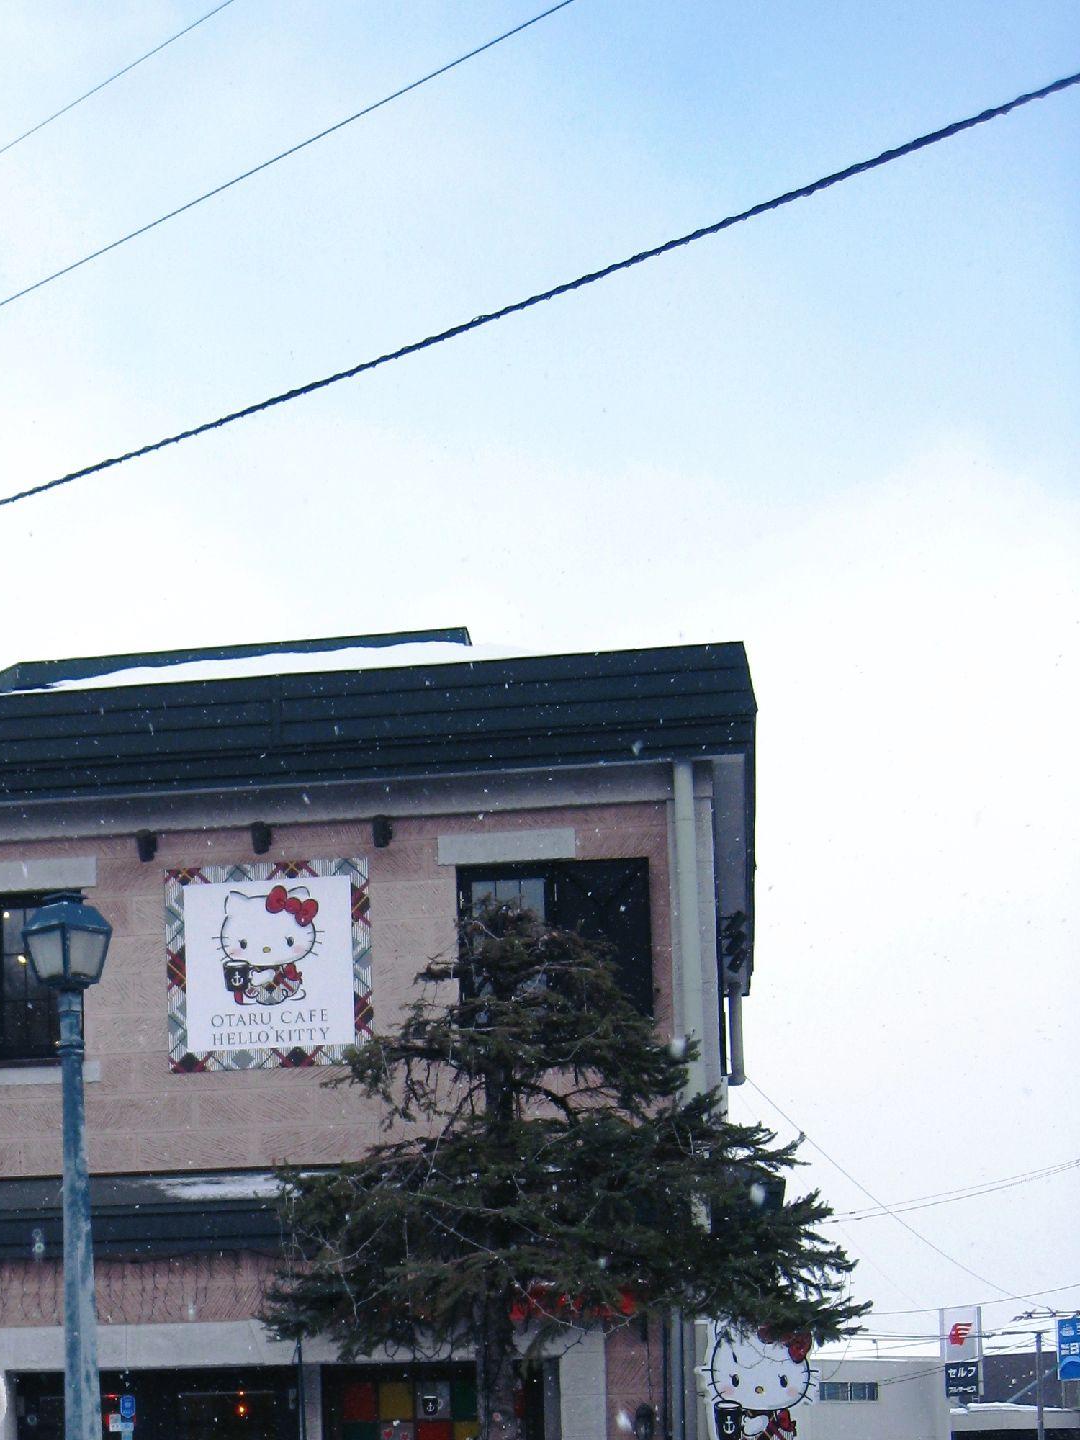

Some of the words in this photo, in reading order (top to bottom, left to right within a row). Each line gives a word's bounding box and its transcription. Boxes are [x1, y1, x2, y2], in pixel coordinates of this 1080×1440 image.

[211, 1012, 272, 1028] OTARU
[281, 1009, 329, 1024] CAFE
[213, 1031, 270, 1046] HELLO
[275, 1027, 330, 1043] KITTY
[947, 1366, 977, 1378] セルフ
